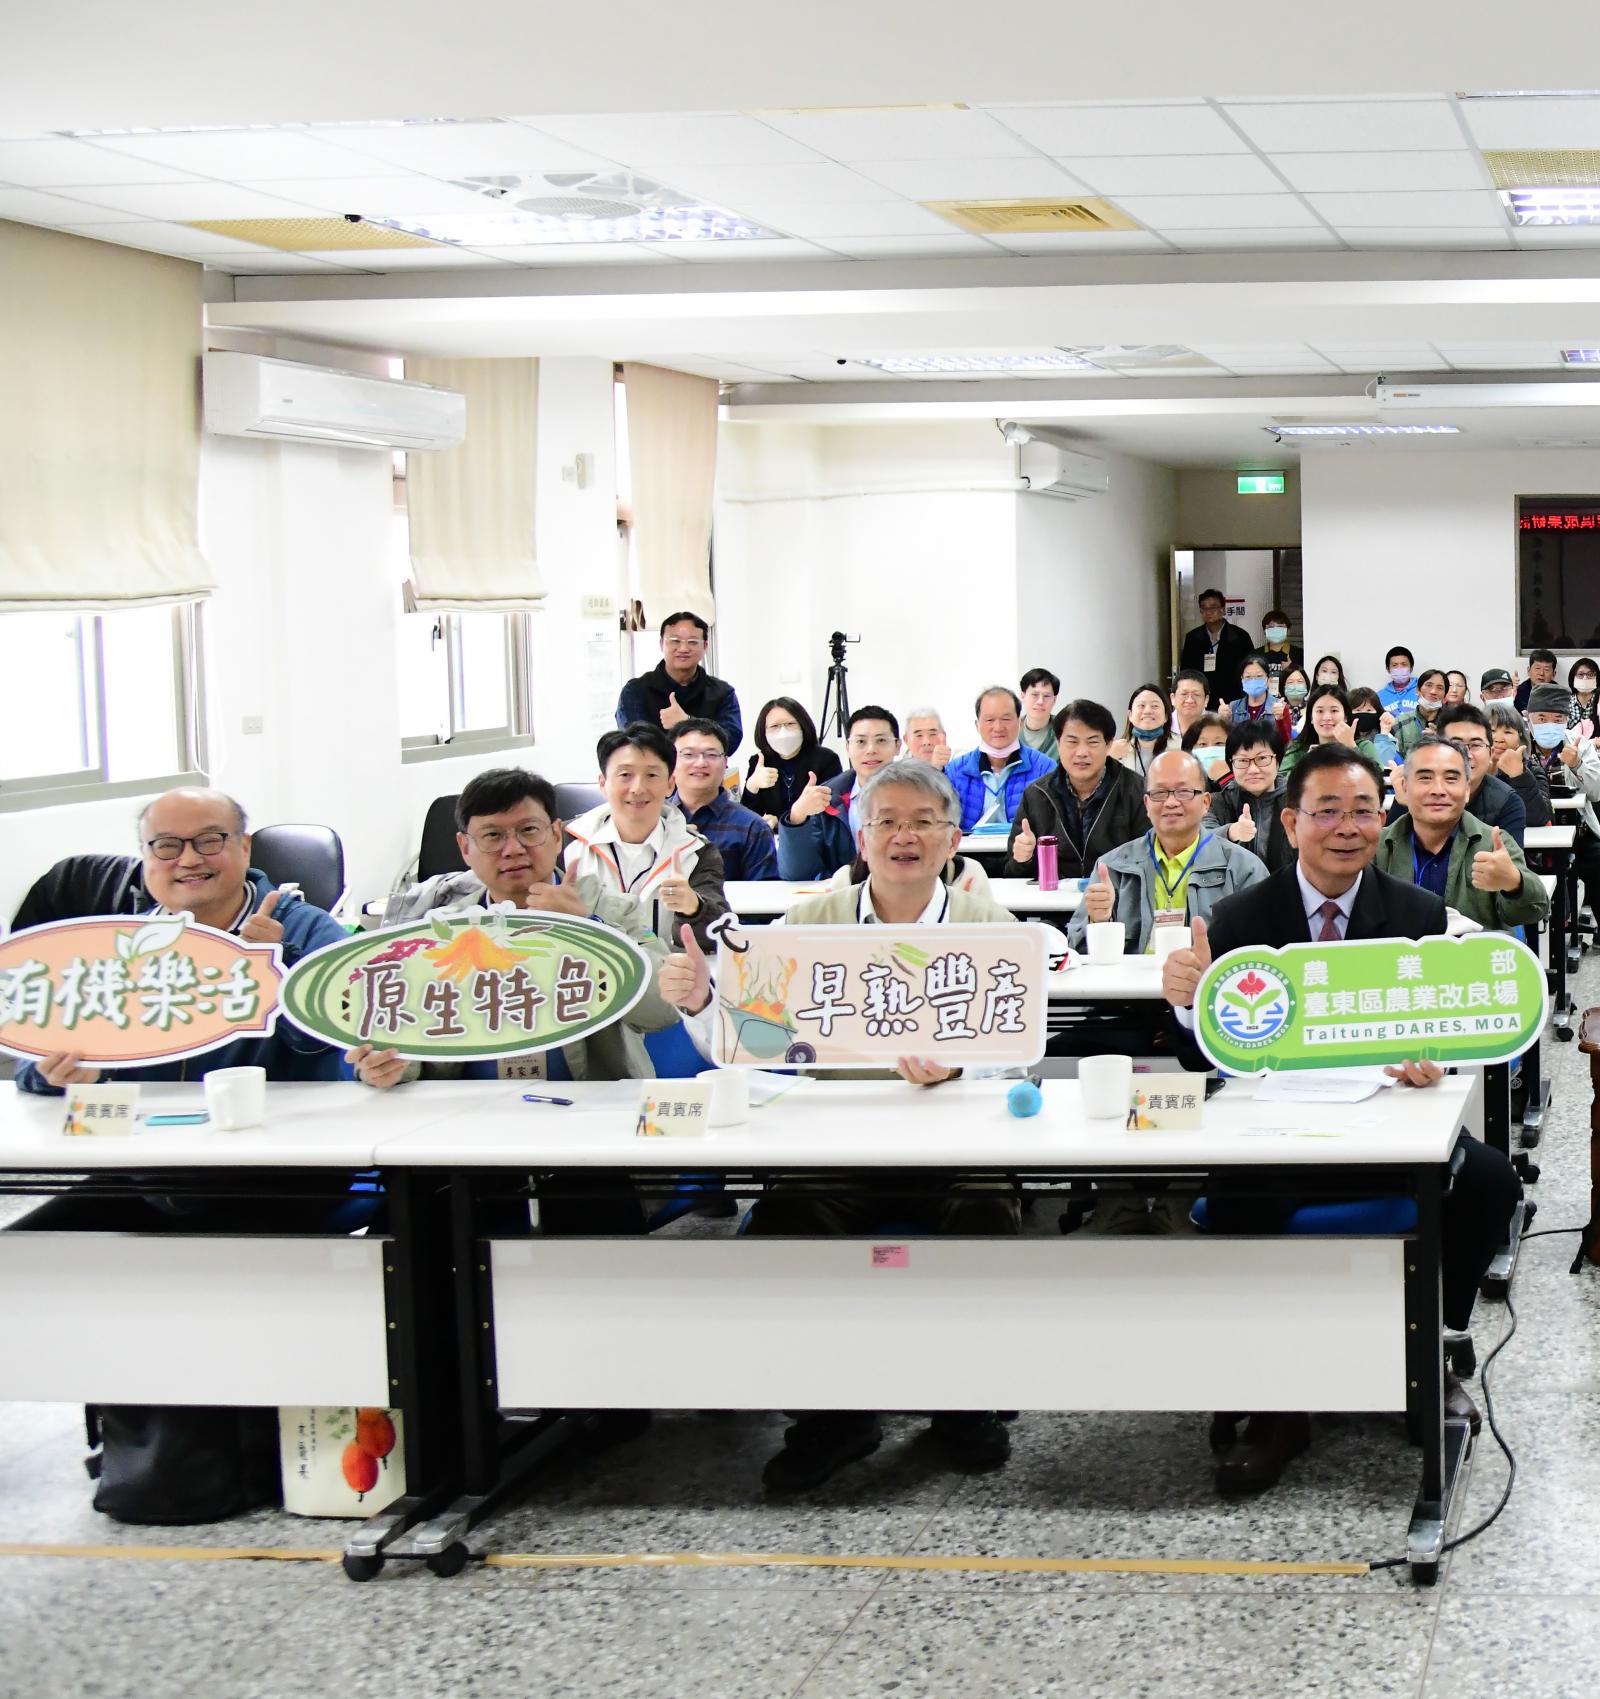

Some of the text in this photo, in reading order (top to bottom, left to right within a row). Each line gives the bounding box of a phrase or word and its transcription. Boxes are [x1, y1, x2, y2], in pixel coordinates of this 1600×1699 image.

[1225, 606, 1245, 616] 手間
[1303, 948, 1518, 987] 農業部
[4, 951, 259, 1031] 有機樂活
[358, 957, 594, 1038] 原生特色
[796, 952, 1027, 1041] 早熟豐產
[1303, 979, 1519, 1017] 臺東區農業改良場
[1306, 1026, 1387, 1041] Taitung
[1395, 1019, 1466, 1035] DARES,
[83, 1102, 129, 1120] 貴賓席
[656, 1102, 703, 1117] 貴賓席
[1148, 1094, 1197, 1110] 貴賓席
